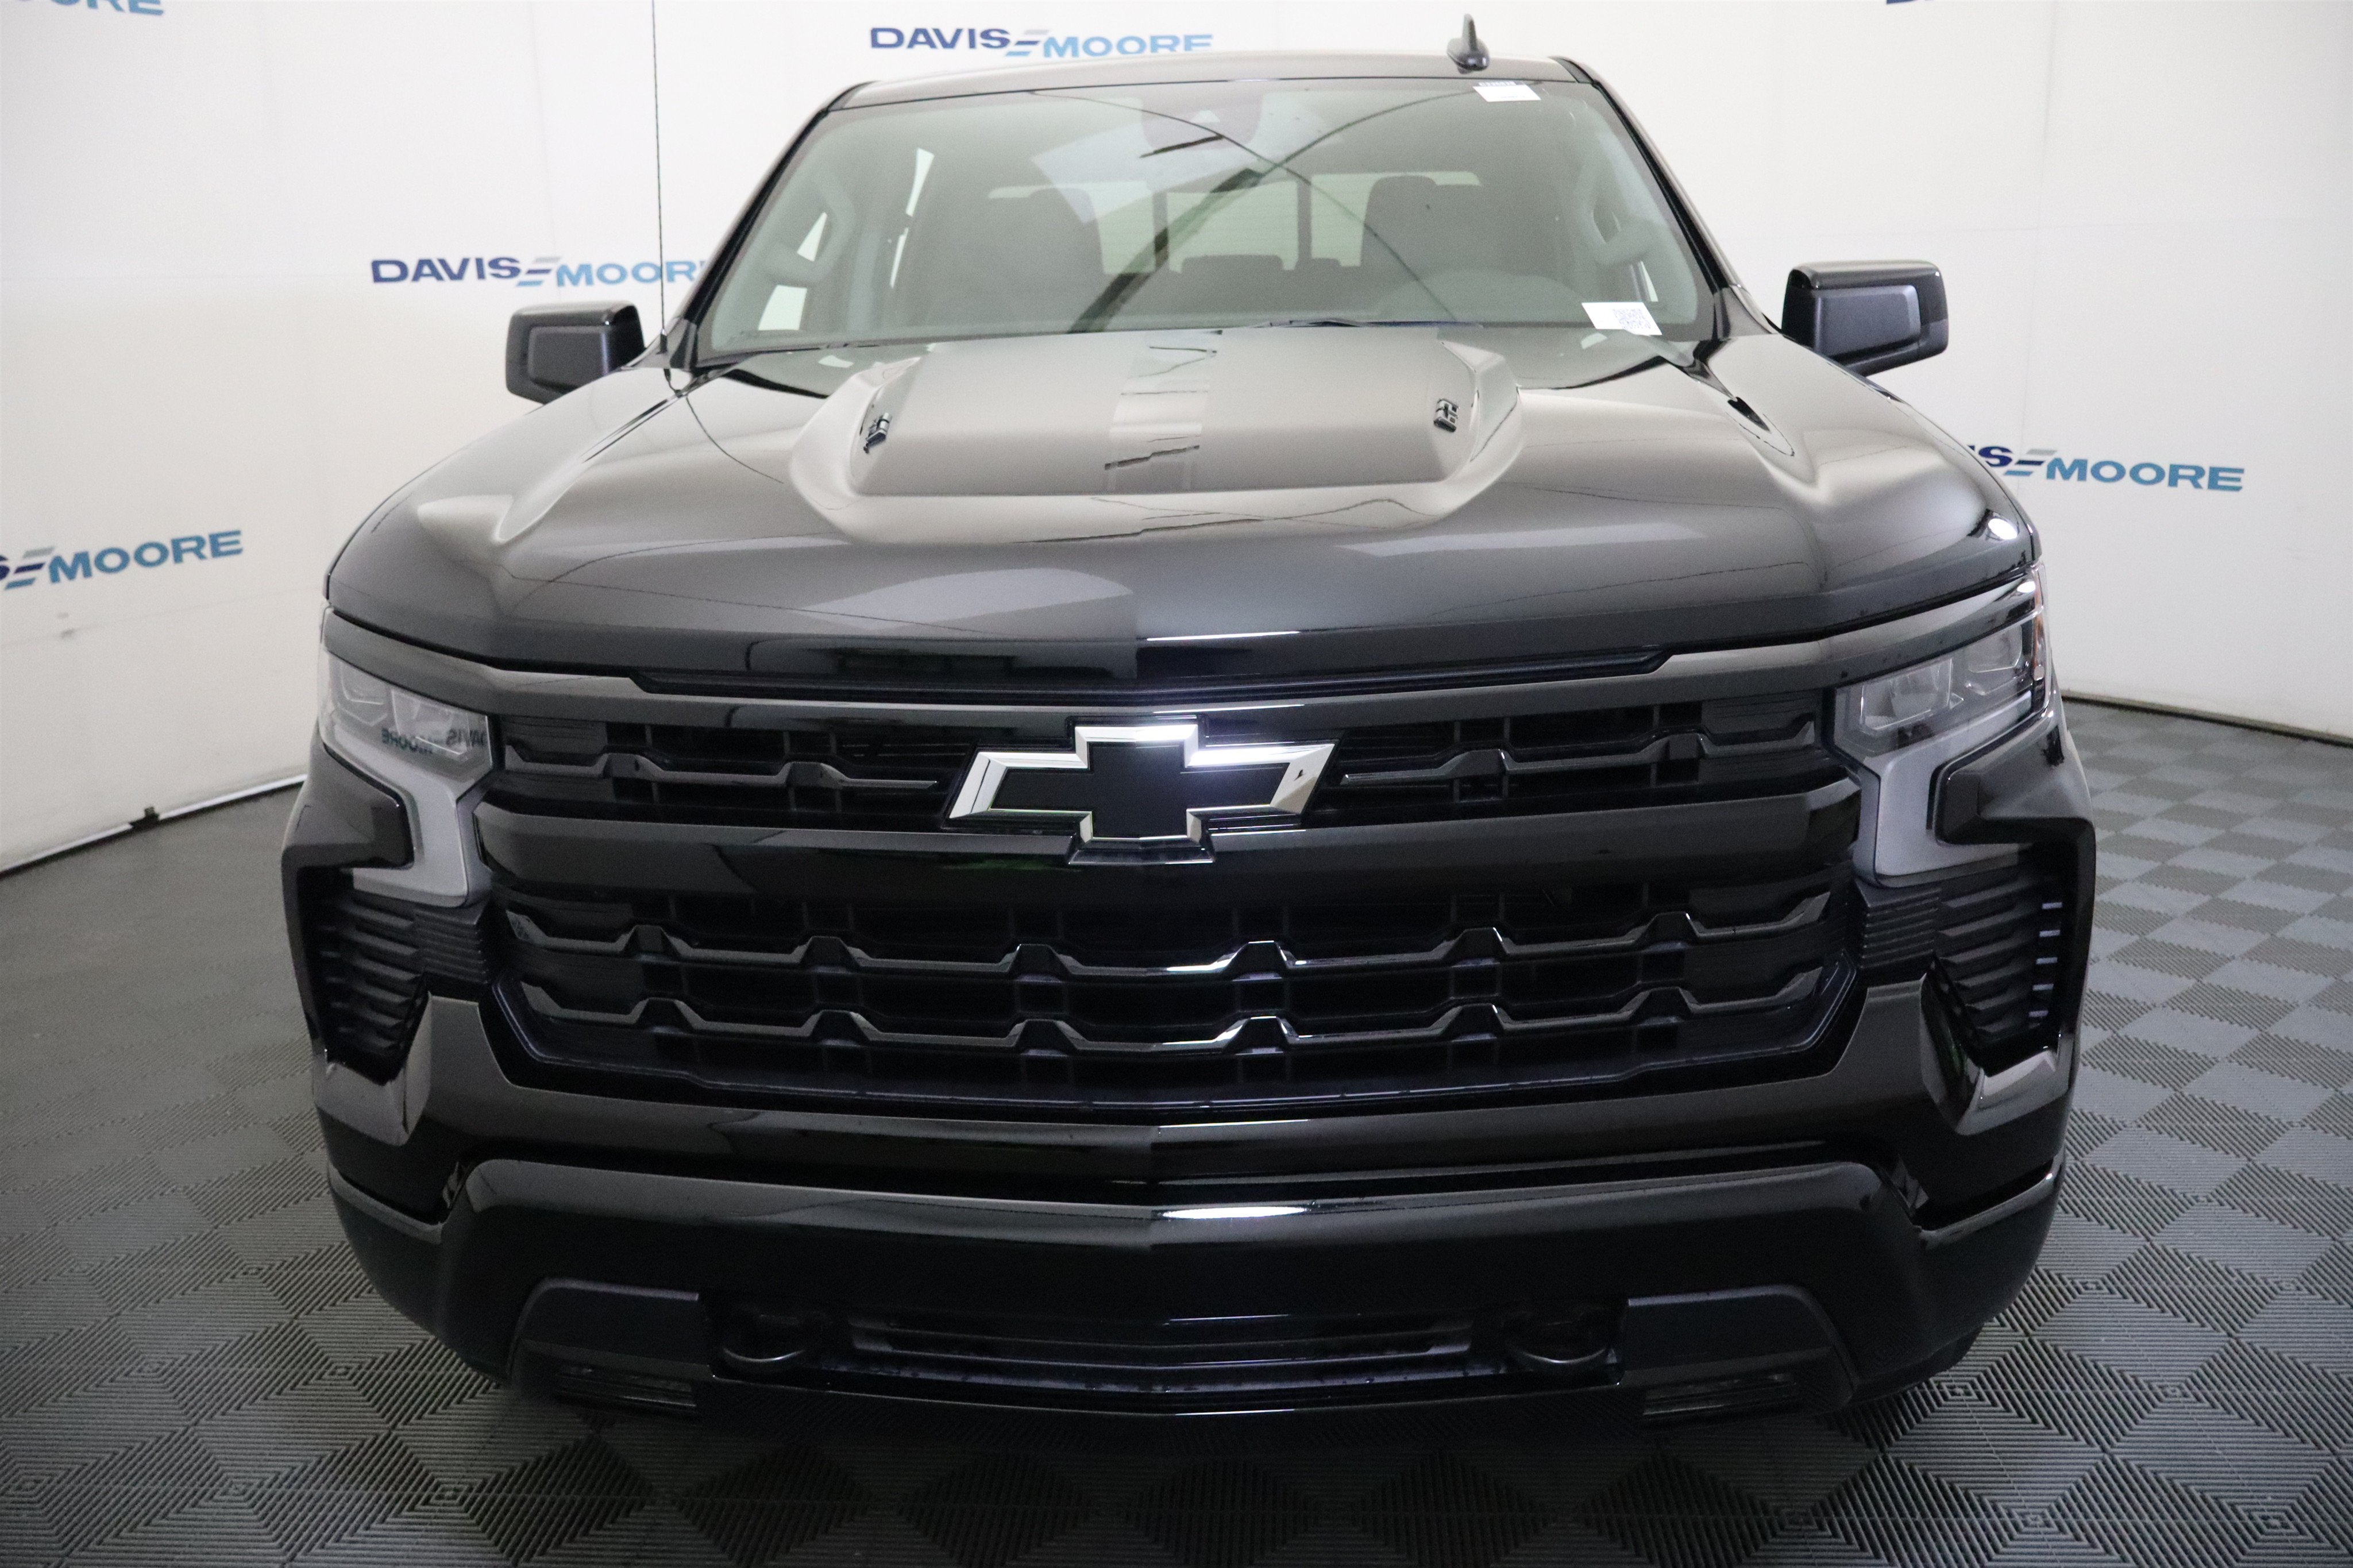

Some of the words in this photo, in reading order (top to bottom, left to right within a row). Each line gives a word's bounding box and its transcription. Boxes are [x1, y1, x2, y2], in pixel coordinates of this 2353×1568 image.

[870, 28, 1010, 49] DAVIS
[371, 257, 520, 284] DAVIS
[556, 261, 705, 287] MOOR
[2046, 457, 2244, 492] MOORE
[49, 530, 244, 584] MOORE
